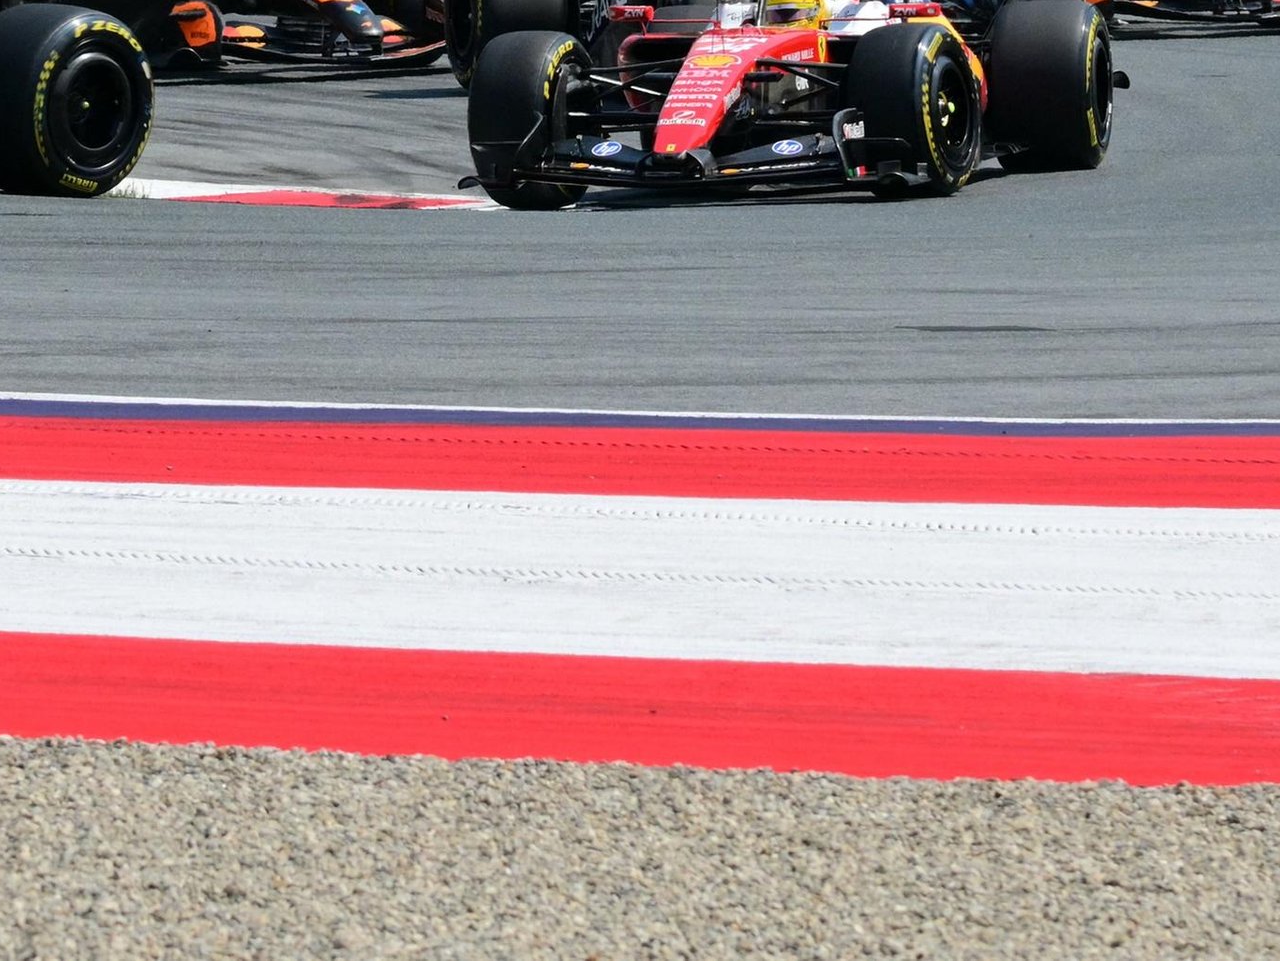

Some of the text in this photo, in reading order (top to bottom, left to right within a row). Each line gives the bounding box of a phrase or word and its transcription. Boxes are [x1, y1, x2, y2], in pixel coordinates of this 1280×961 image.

[624, 8, 645, 17] ZYN
[895, 7, 917, 16] ZYN
[90, 20, 144, 53] ZERO
